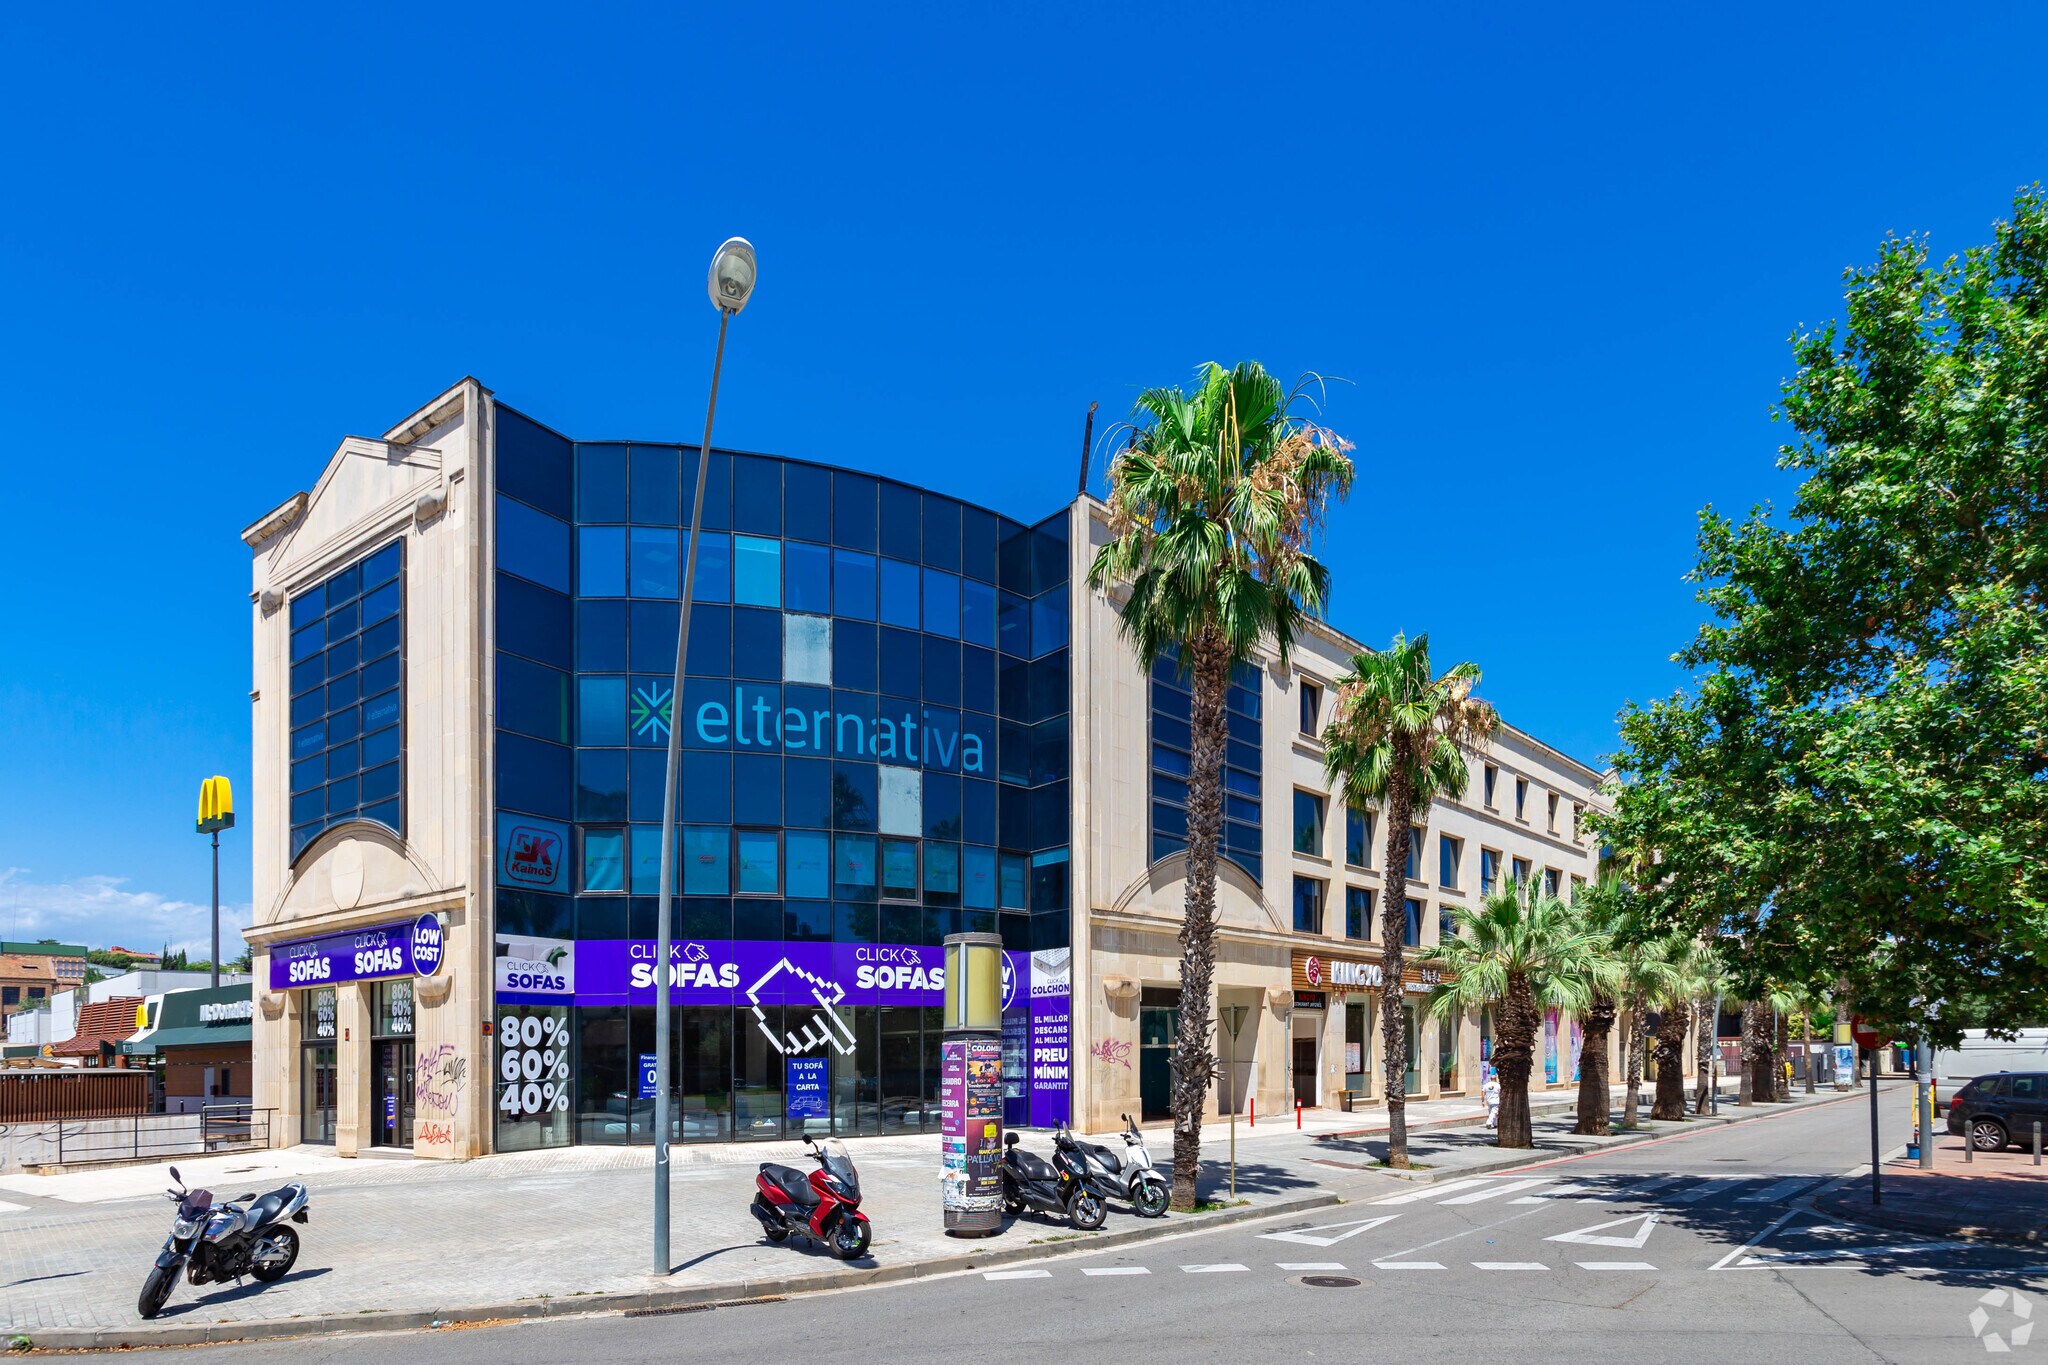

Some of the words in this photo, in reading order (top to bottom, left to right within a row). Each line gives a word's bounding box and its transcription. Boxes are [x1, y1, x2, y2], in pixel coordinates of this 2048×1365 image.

[696, 686, 984, 773] elternativa
[354, 933, 376, 948] CLICK
[415, 928, 440, 945] LOW
[289, 945, 309, 959] CLICK
[414, 946, 439, 962] COST
[630, 944, 681, 958] CLIK
[855, 947, 900, 961] CLICK
[354, 947, 402, 974] SOFAS
[506, 961, 535, 971] CLICK
[289, 957, 331, 982] SOFAS
[855, 965, 945, 990] SOFAS
[1330, 960, 1383, 987] KINGYO
[507, 973, 566, 990] SOFAS
[1032, 984, 1070, 994] COLCHON
[317, 990, 335, 1006] 80%
[391, 983, 412, 1000] 80%
[317, 1006, 335, 1021] 60%
[391, 1000, 412, 1016] 60%
[391, 1016, 412, 1033] 40%
[1043, 1015, 1068, 1023] MILLOR
[317, 1021, 335, 1037] 40%
[500, 1016, 570, 1047] 80%
[1034, 1026, 1068, 1034] DESCANS
[1034, 1047, 1068, 1062] PREU
[501, 1049, 570, 1081] 60%
[804, 1061, 824, 1070] SOFÁ
[1034, 1063, 1068, 1079] MÍNIM
[1034, 1082, 1068, 1090] GARANTIT
[500, 1082, 569, 1115] 40%
